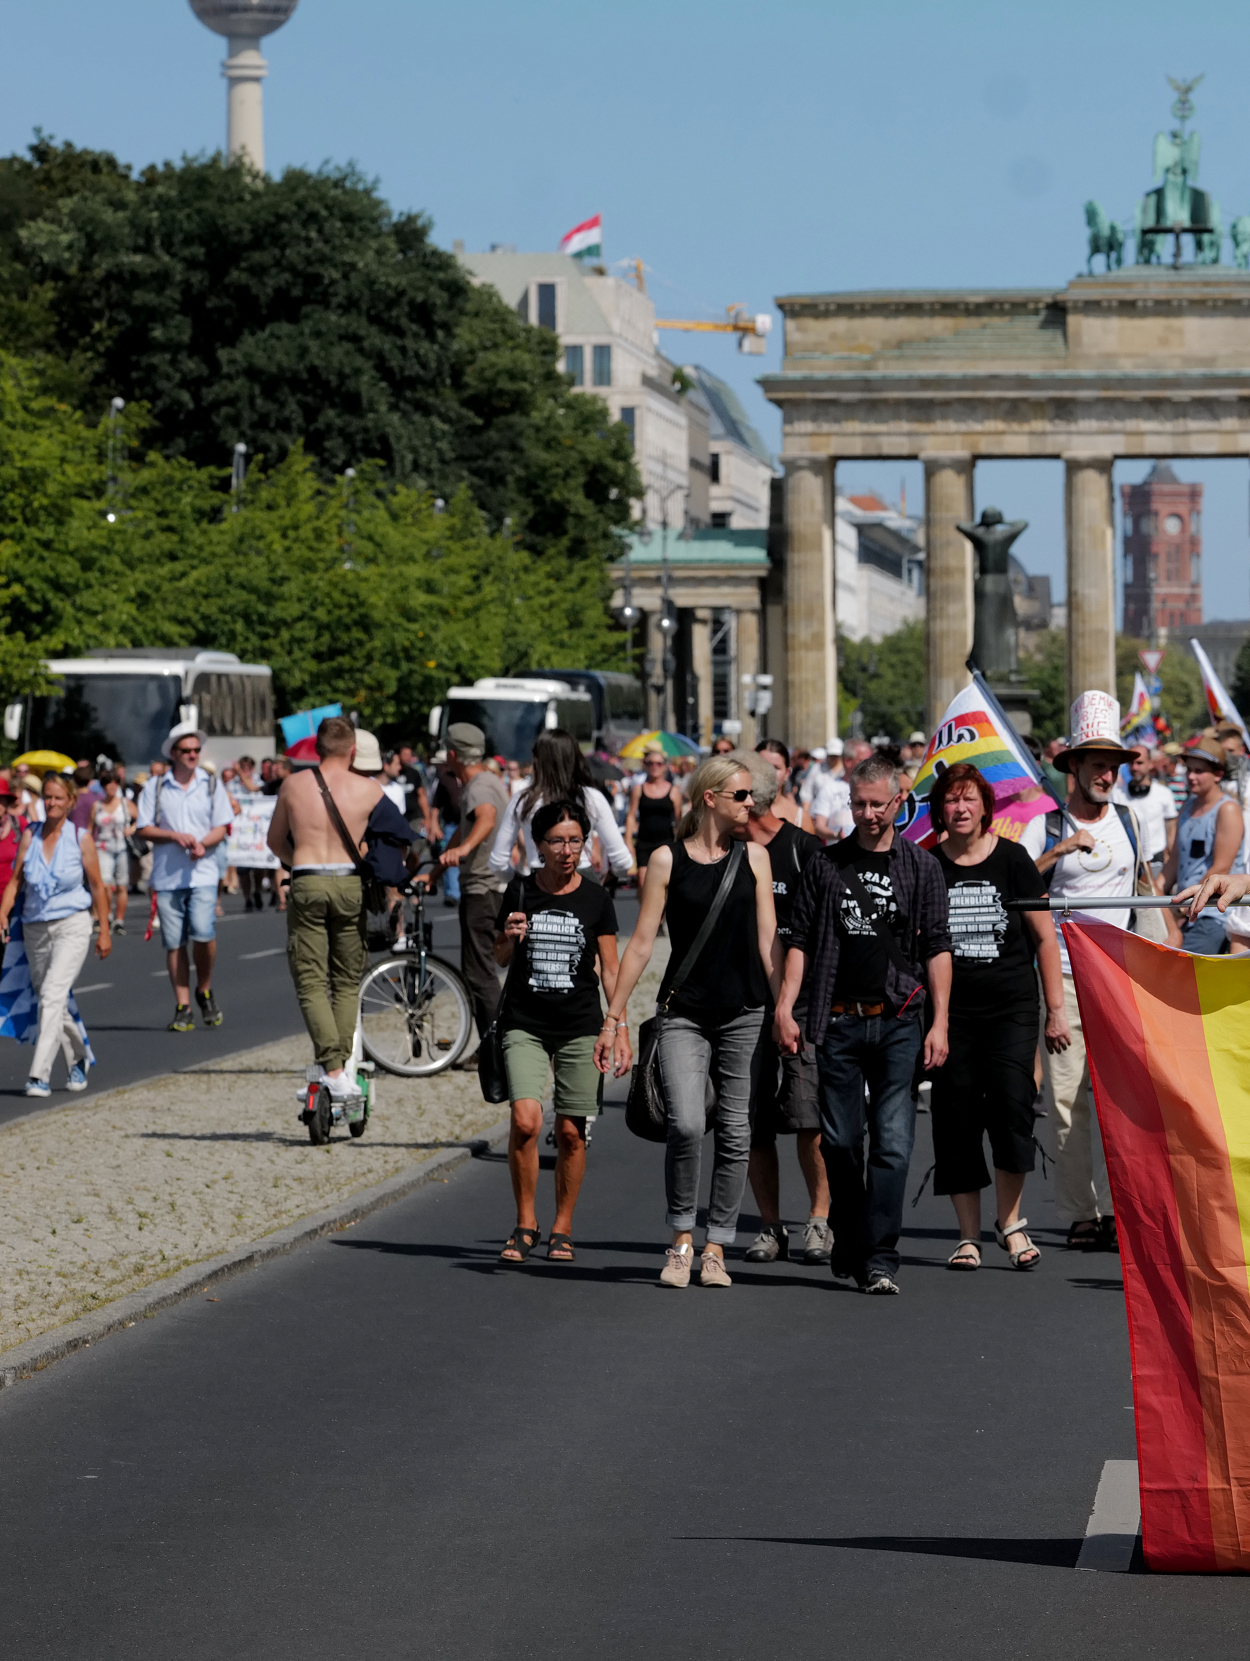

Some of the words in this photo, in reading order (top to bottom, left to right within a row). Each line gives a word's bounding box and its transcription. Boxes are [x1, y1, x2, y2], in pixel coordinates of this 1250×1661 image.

[950, 895, 993, 905] UNENDLICH
[532, 923, 575, 934] UNENDLICH
[532, 962, 570, 972] UNIVERSUM
